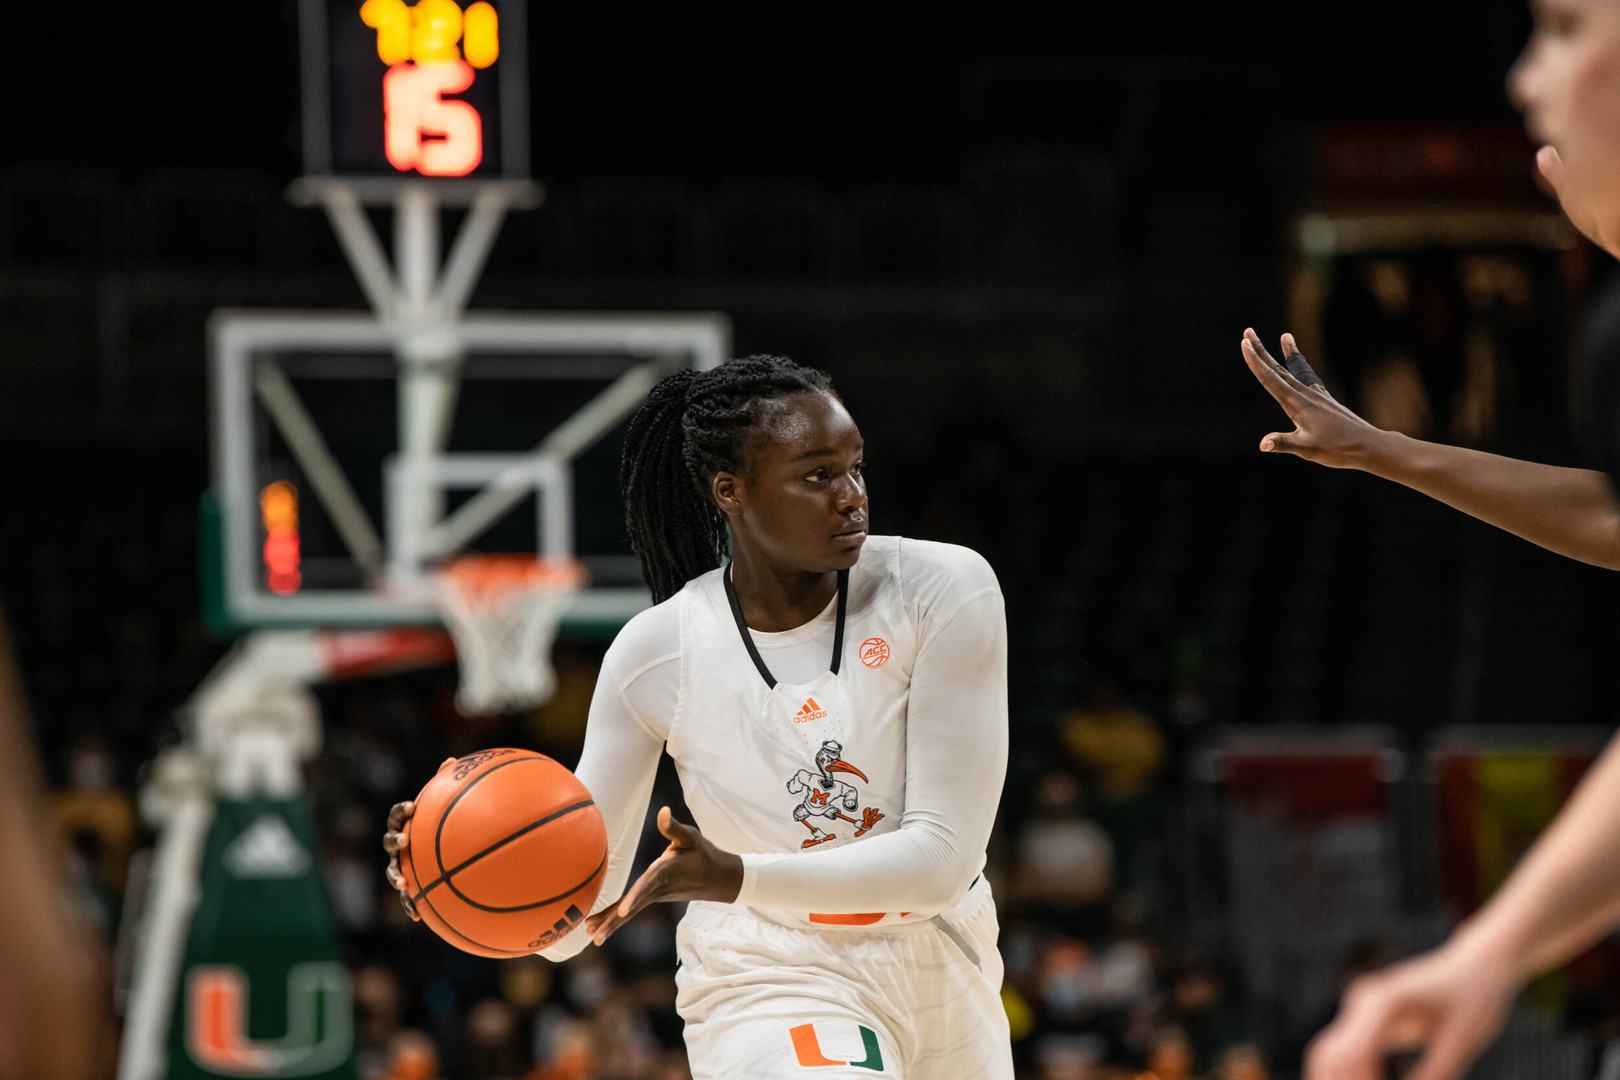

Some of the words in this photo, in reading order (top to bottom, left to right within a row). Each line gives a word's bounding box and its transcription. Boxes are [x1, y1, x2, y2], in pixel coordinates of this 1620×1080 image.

[863, 643, 887, 658] ACC
[793, 709, 828, 724] adidas
[810, 788, 830, 805] M
[185, 961, 354, 1078] U
[788, 1022, 885, 1073] U
